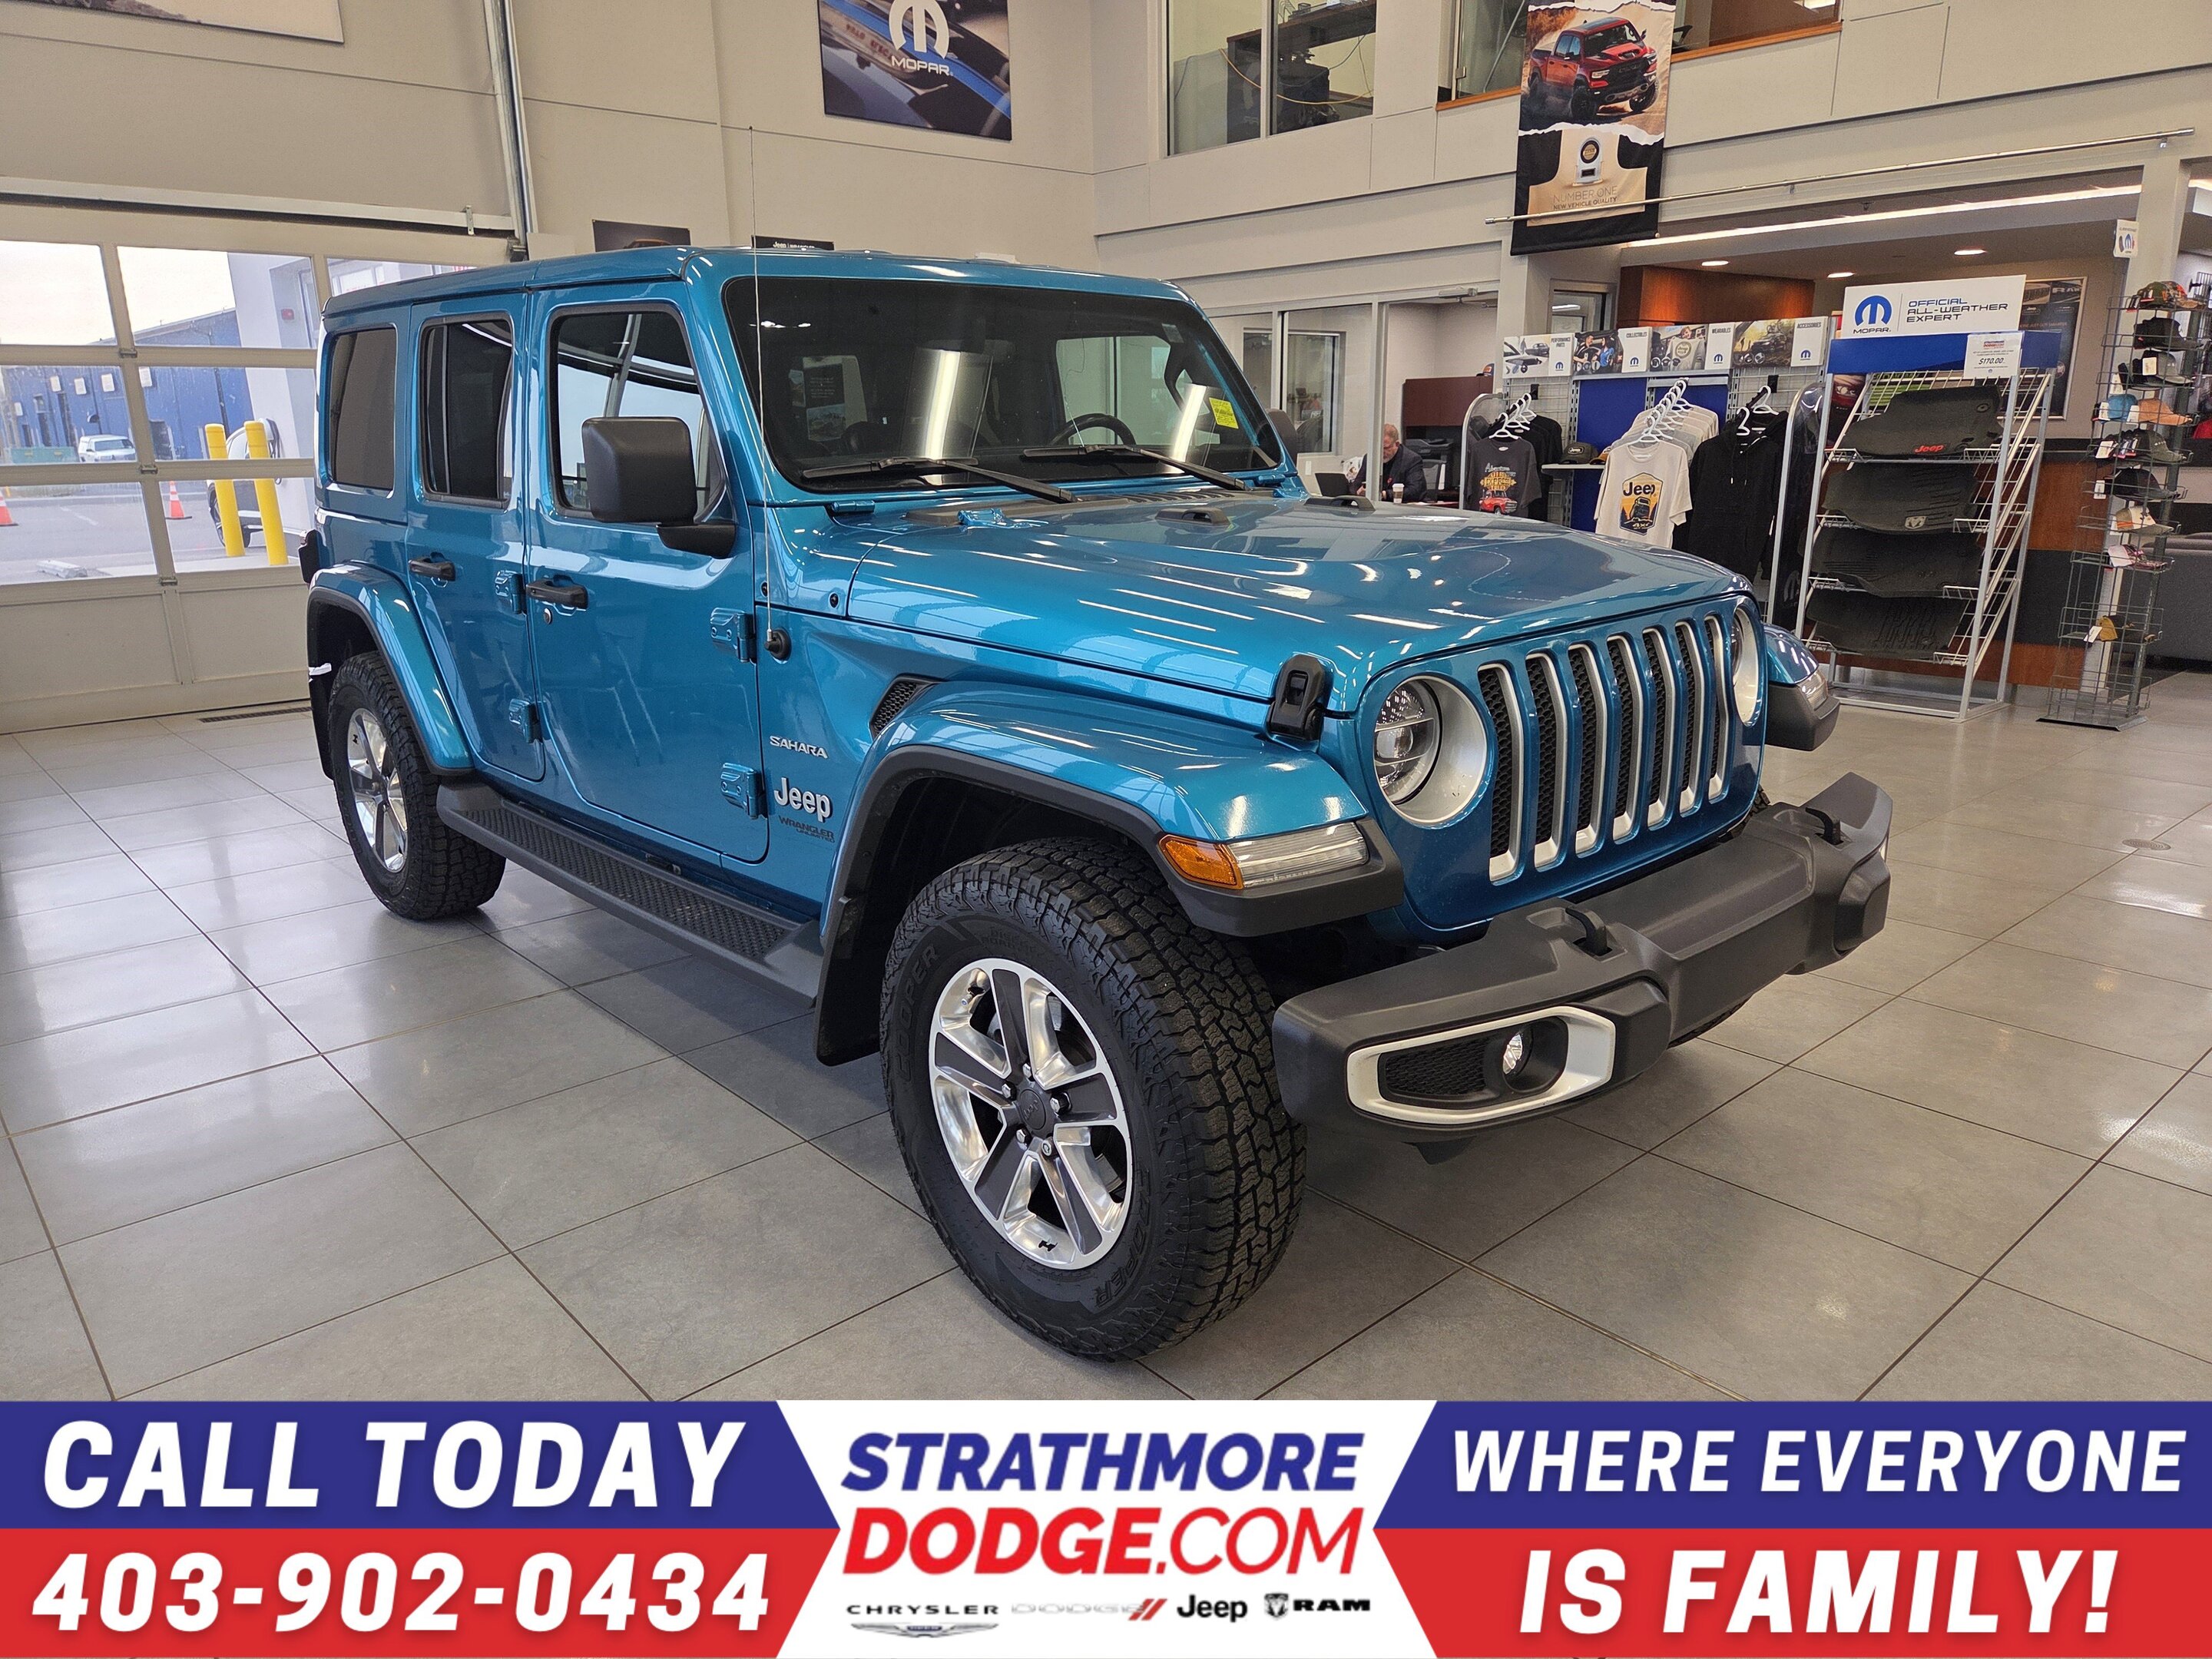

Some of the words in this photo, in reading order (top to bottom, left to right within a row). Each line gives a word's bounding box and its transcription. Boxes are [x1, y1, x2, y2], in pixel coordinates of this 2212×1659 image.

[892, 56, 951, 76] MOPAR
[1553, 189, 1594, 203] NUMBER
[1597, 185, 1618, 197] ONE
[1593, 197, 1618, 205] QUALITY
[1907, 303, 2008, 315] ALL-WEATHER
[1909, 298, 1968, 307] OFFICIAL
[1906, 313, 1962, 323] EXPERT
[1915, 444, 1945, 453] Jeep
[770, 735, 829, 759] SAHARA
[773, 777, 832, 823] Jeep
[779, 815, 835, 838] WRANGLER
[796, 828, 836, 843] UNLIMITED
